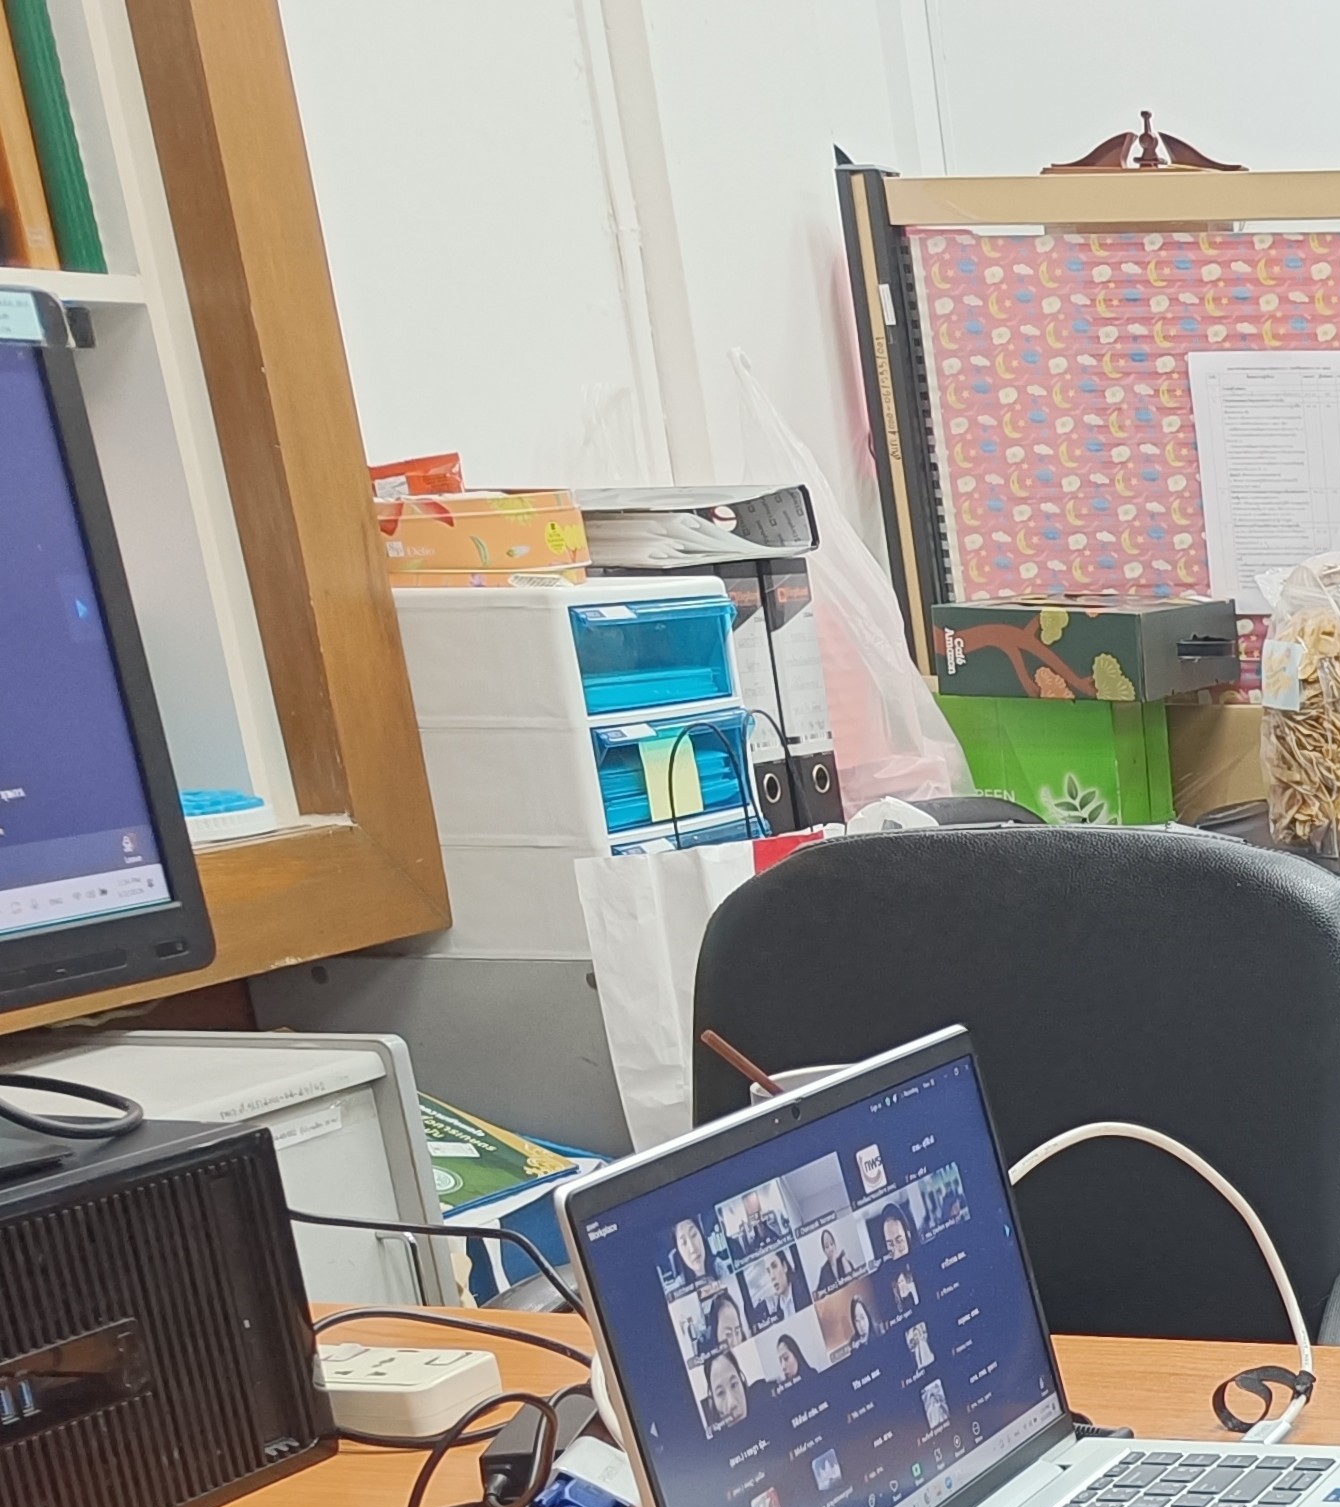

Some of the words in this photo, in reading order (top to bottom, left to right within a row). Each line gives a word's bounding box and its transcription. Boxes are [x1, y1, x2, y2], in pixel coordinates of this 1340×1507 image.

[944, 627, 956, 675] Amazon
[975, 789, 1015, 802] REEN
[588, 1223, 618, 1242] Workplace
